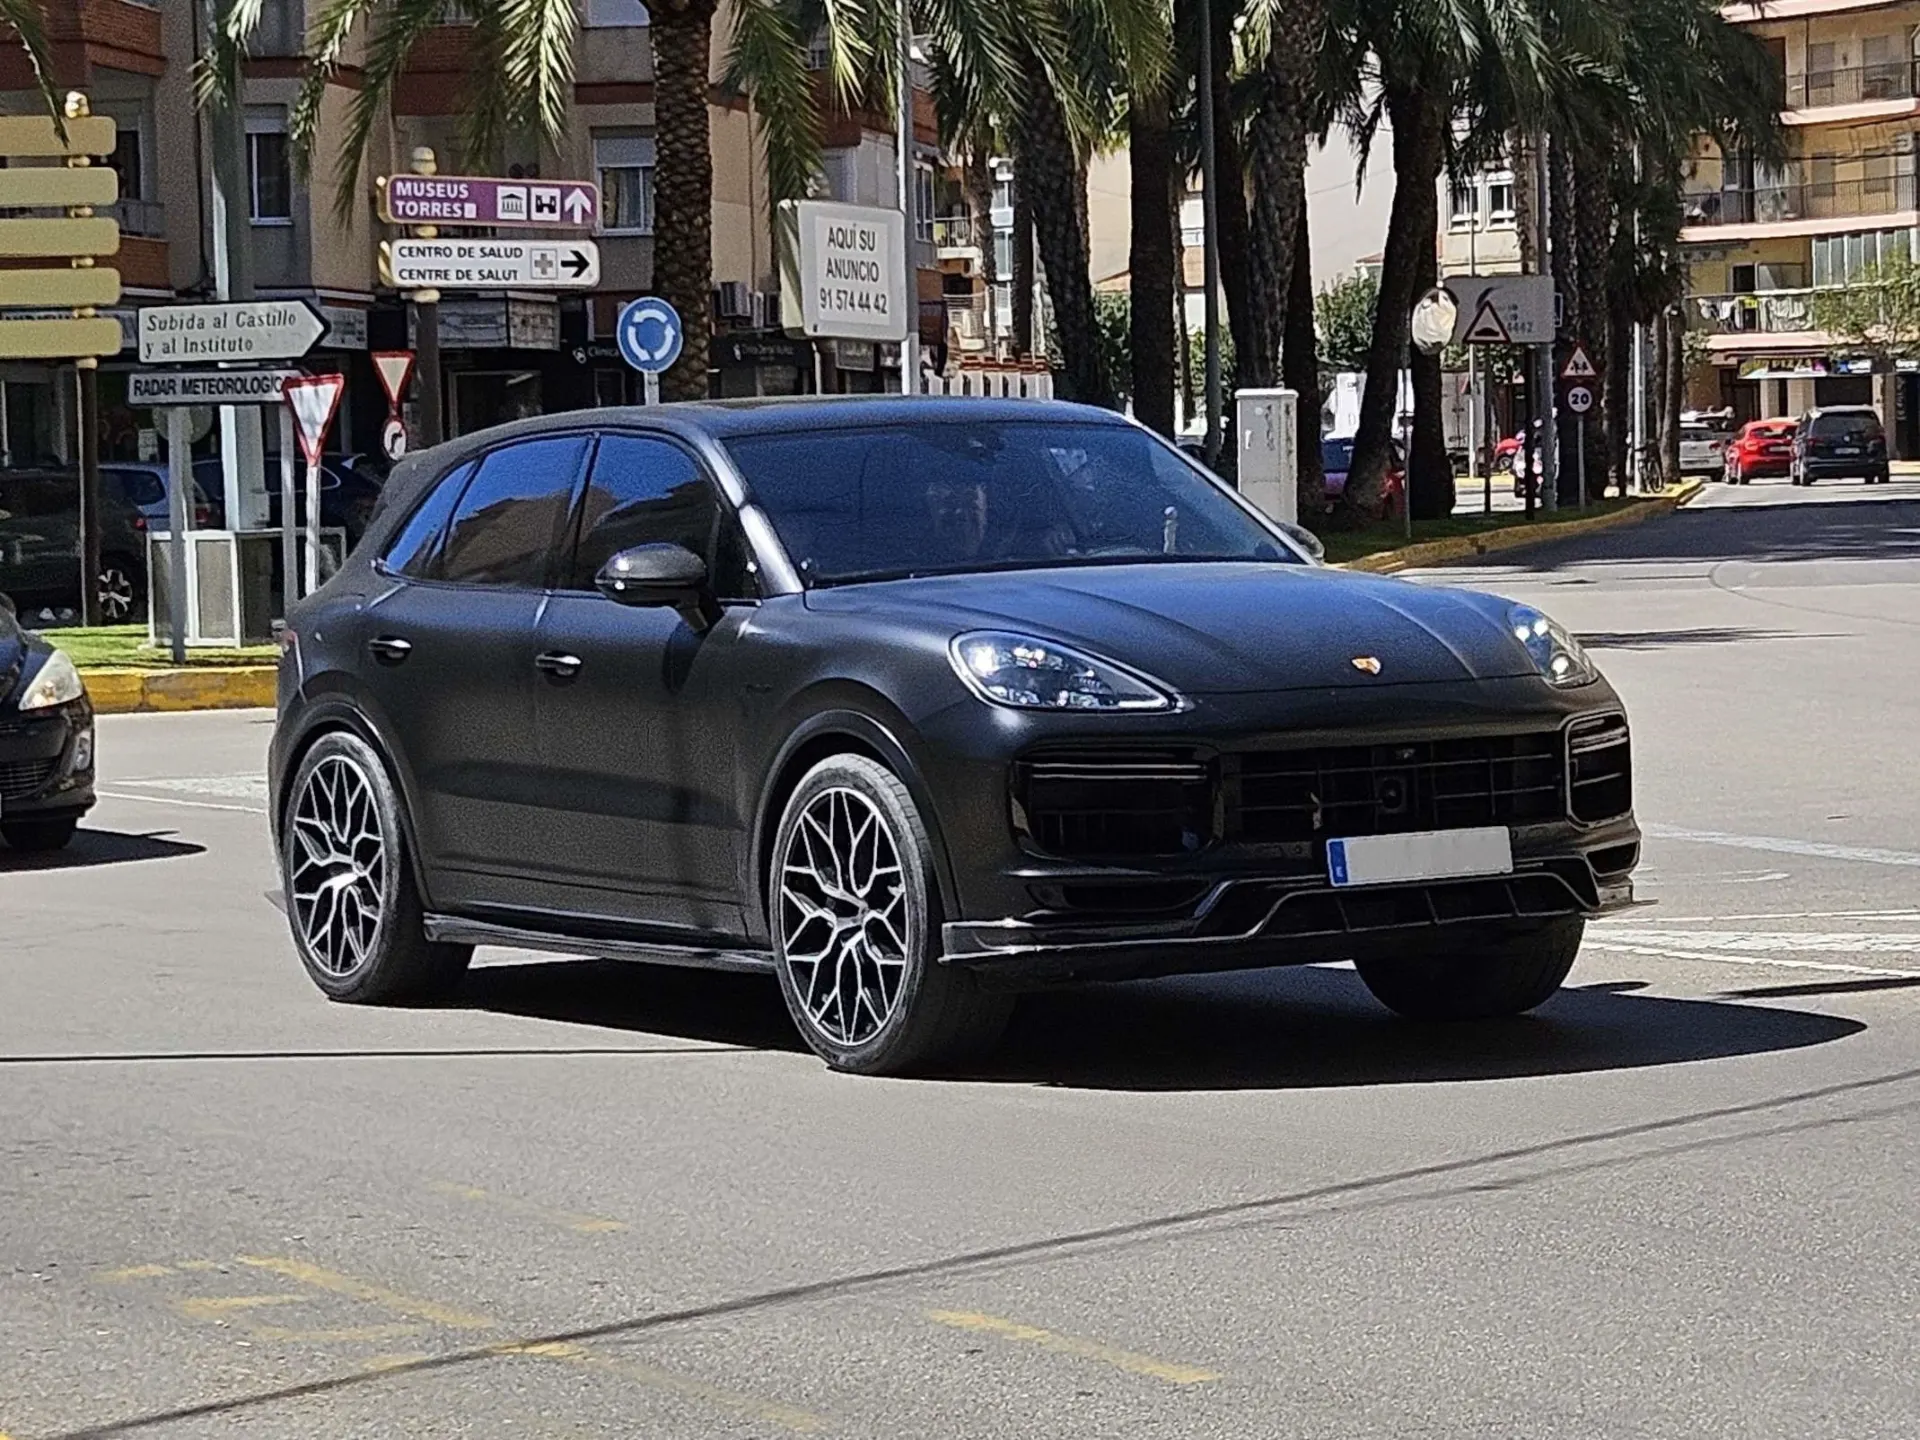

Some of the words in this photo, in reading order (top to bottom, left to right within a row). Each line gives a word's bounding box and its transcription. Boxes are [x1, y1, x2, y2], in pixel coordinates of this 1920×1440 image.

[395, 181, 469, 199] MUSEUS
[395, 200, 462, 218] TORRES
[859, 230, 876, 252] SU
[398, 246, 452, 258] CENTRO
[457, 246, 475, 258] DE
[479, 247, 523, 259] SALUD
[398, 268, 451, 280] CENTRE
[455, 269, 472, 281] DE
[476, 269, 519, 281] SALUT
[826, 257, 879, 283] ANUNCIO
[819, 287, 832, 310] 91
[836, 289, 856, 311] 574
[857, 291, 871, 313] 44
[873, 293, 888, 315] 42
[146, 314, 205, 332] Subida
[213, 312, 228, 329] al
[235, 310, 296, 328] Castillo
[145, 342, 154, 359] y
[161, 338, 176, 354] al
[183, 337, 254, 354] Instituto
[133, 379, 177, 396] RADAR
[181, 375, 291, 396] METEOROLOGIC
[1571, 392, 1590, 406] 20
